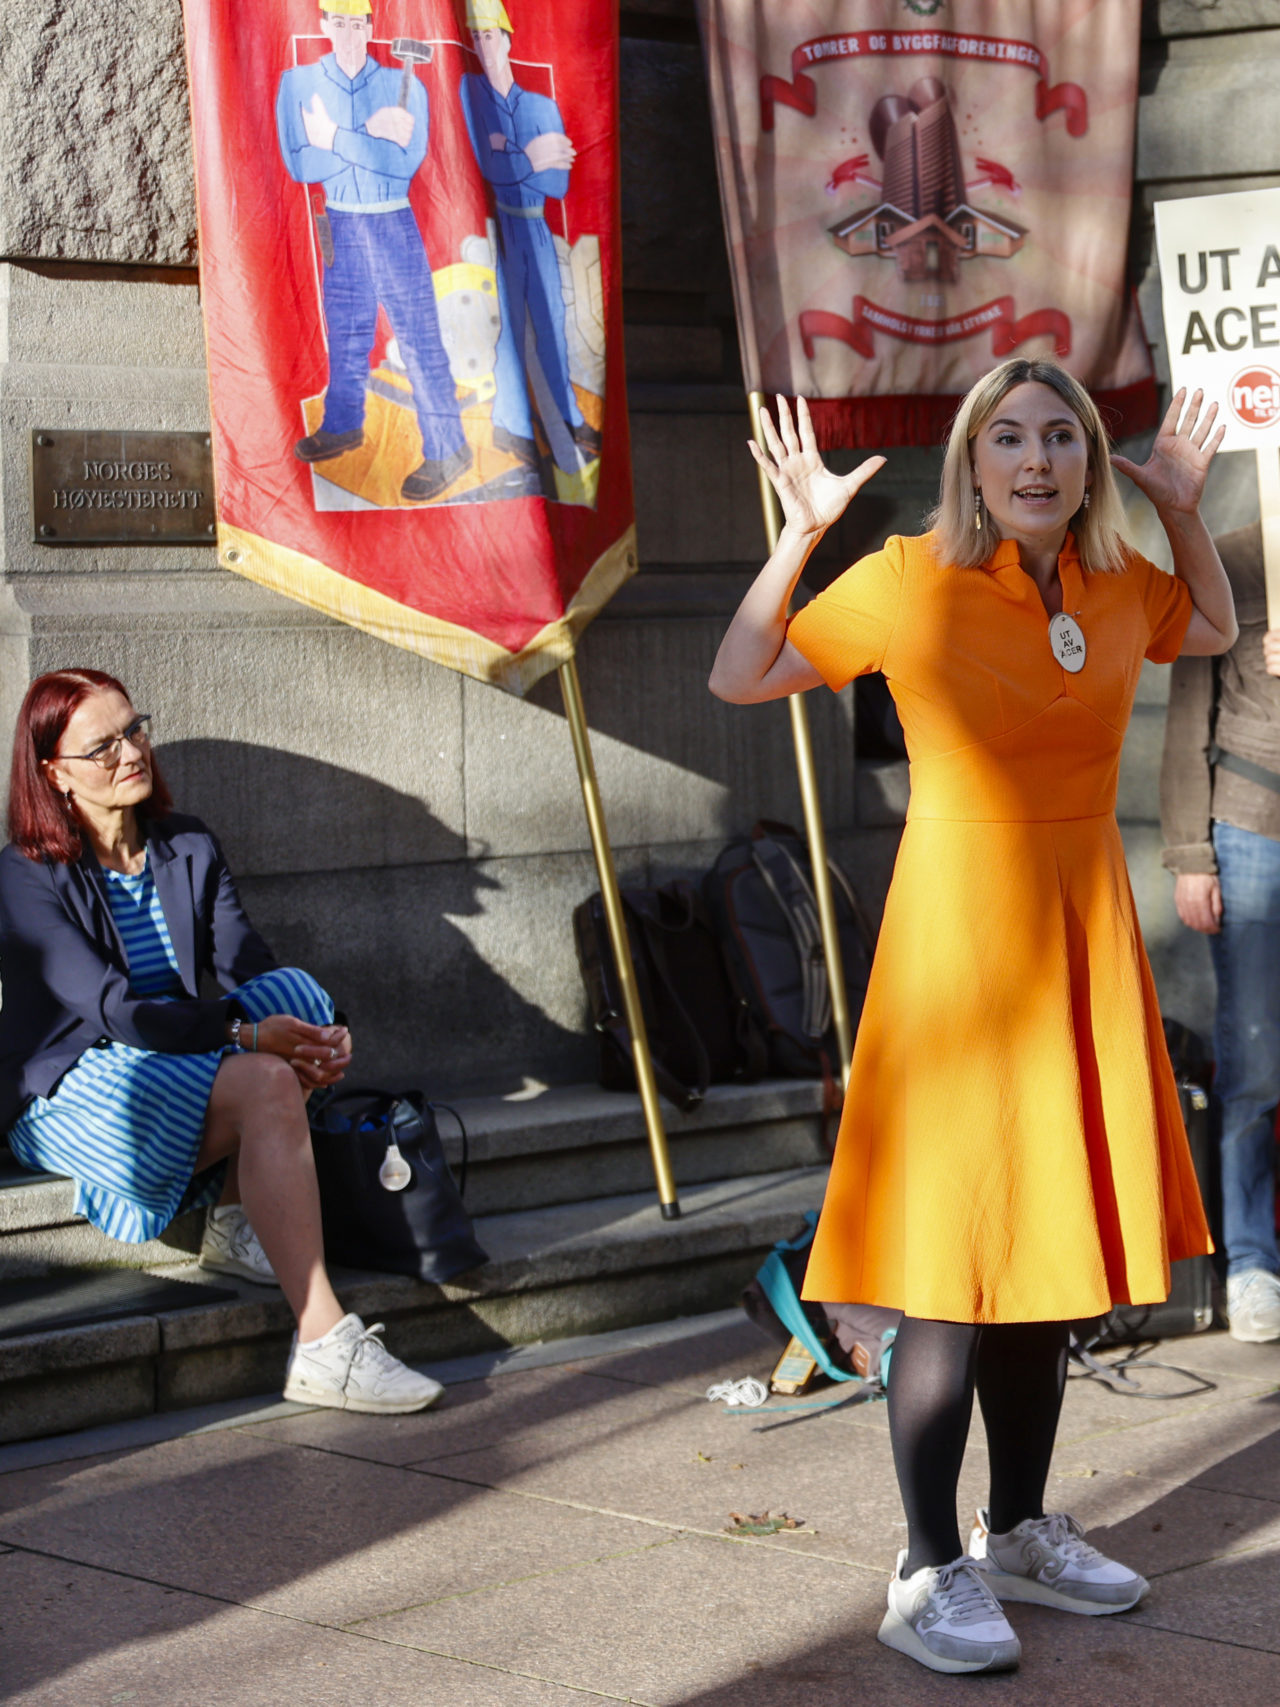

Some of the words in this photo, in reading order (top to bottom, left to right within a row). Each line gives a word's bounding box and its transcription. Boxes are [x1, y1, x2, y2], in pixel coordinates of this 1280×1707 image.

[868, 35, 886, 50] OG
[1177, 248, 1241, 295] UT
[1234, 374, 1280, 409] nei
[83, 460, 172, 481] NORGES
[53, 489, 204, 510] HØYESTERETT
[1060, 630, 1070, 640] UT
[1063, 639, 1074, 649] AV
[1060, 645, 1083, 659] ACER
